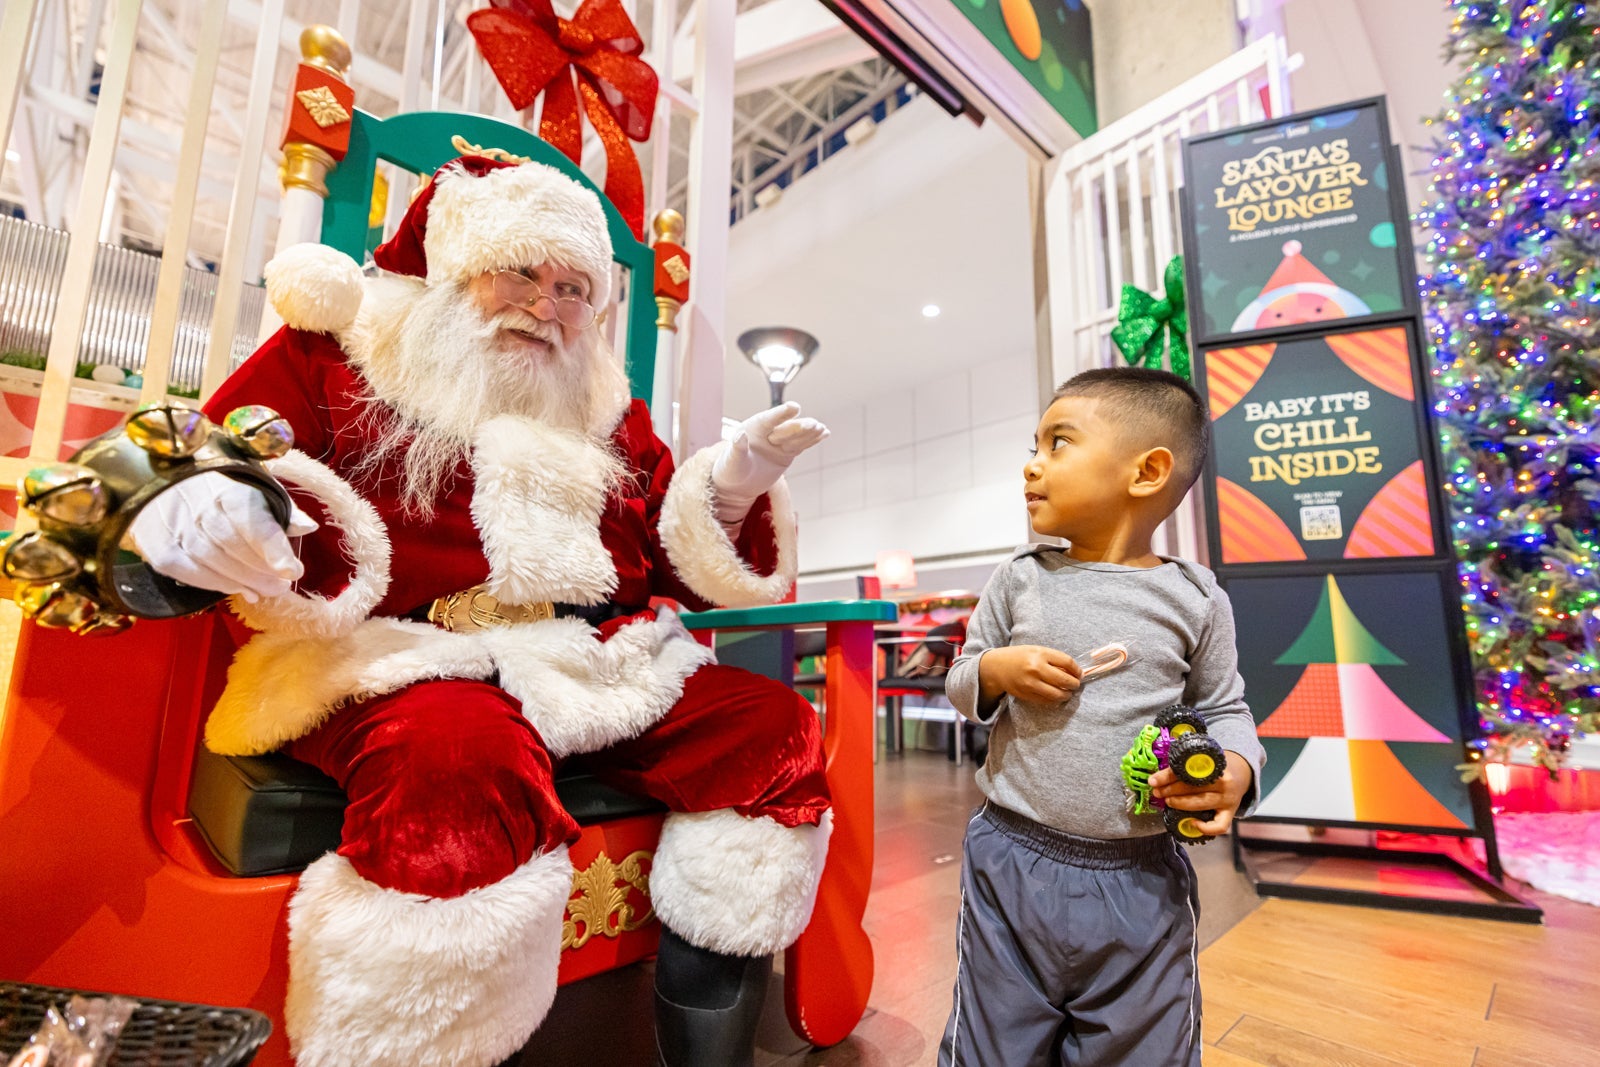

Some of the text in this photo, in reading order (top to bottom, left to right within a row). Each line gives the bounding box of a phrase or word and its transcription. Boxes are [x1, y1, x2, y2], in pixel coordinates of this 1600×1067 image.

[1221, 138, 1350, 186] SANTA'S
[1214, 162, 1368, 208] LAYOVER
[1227, 187, 1353, 231] LOUNGE
[1244, 391, 1371, 421] BABY IT'S
[1254, 416, 1372, 451] CHILL
[1249, 446, 1382, 486] INSIDE
